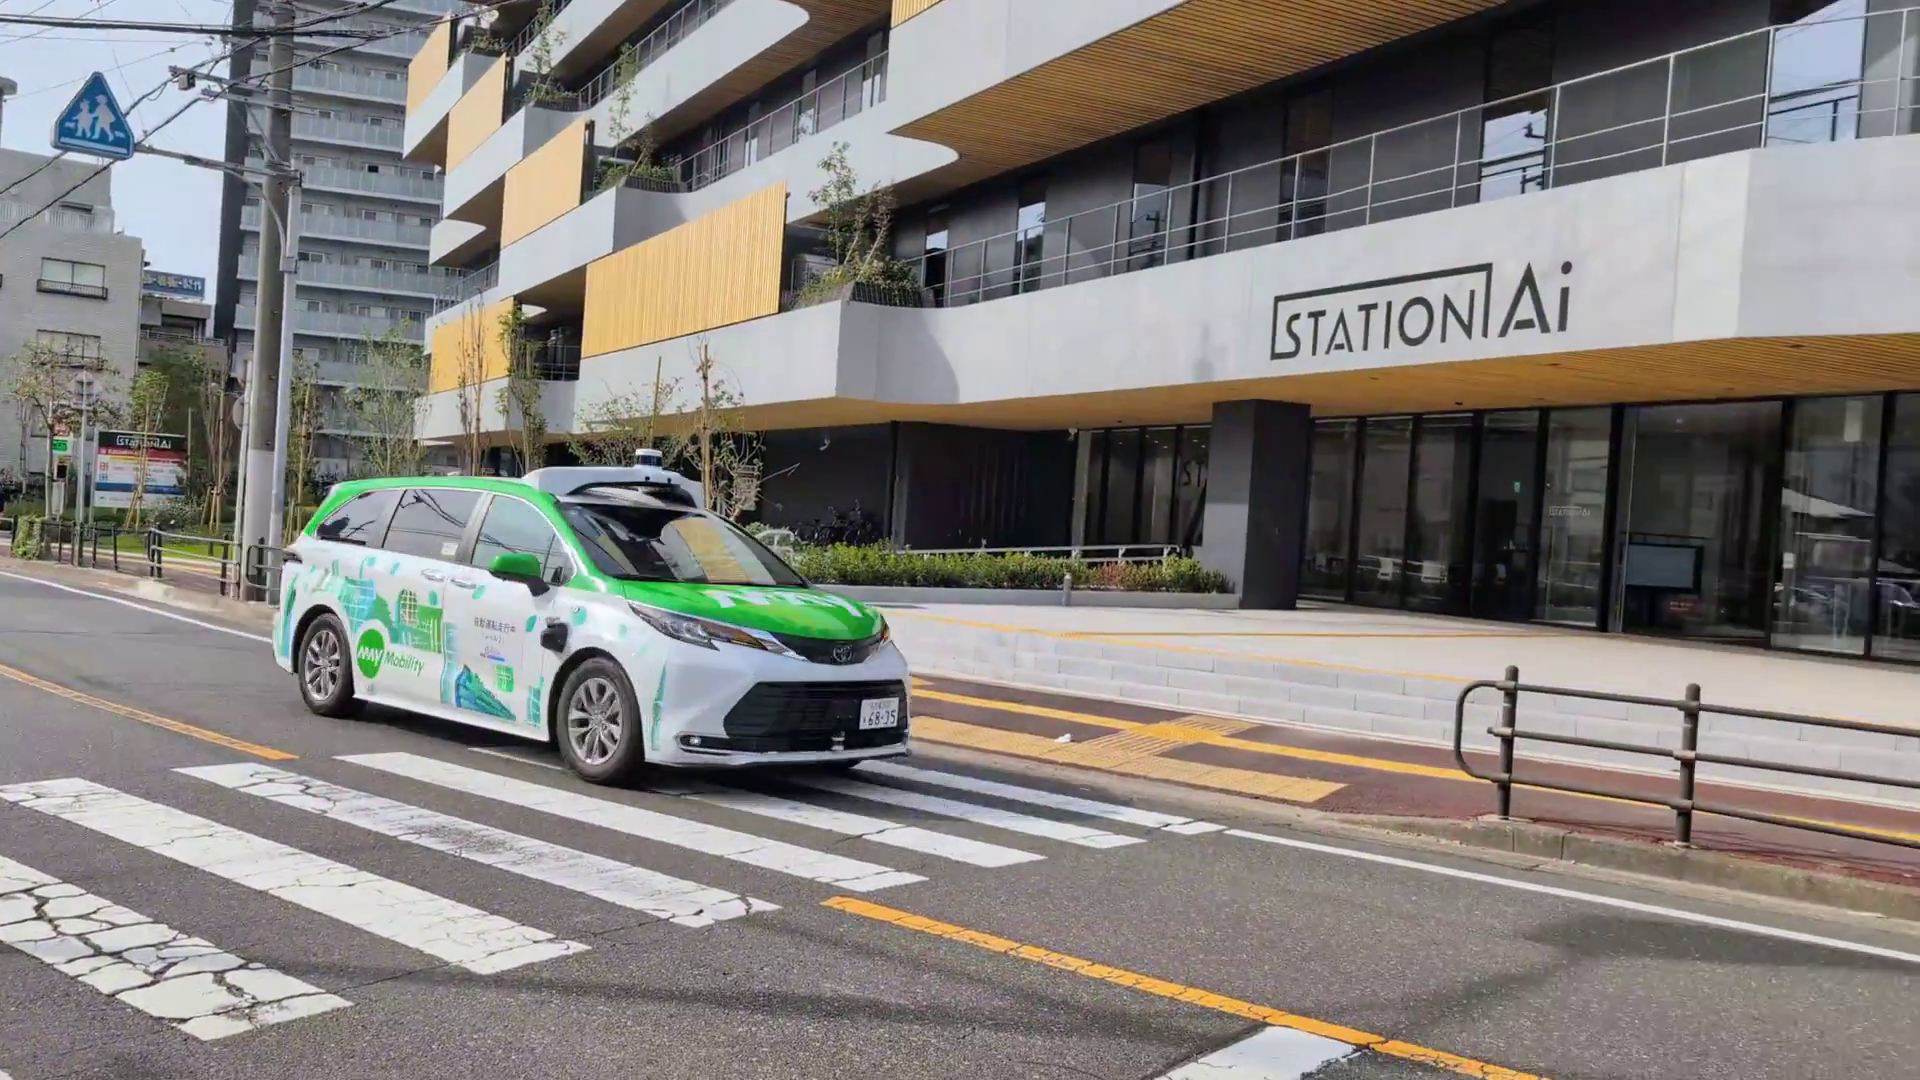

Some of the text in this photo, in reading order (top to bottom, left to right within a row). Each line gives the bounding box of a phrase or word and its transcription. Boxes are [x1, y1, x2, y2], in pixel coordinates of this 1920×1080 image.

[1271, 261, 1573, 360] STATION Ai
[384, 651, 424, 676] Mobility
